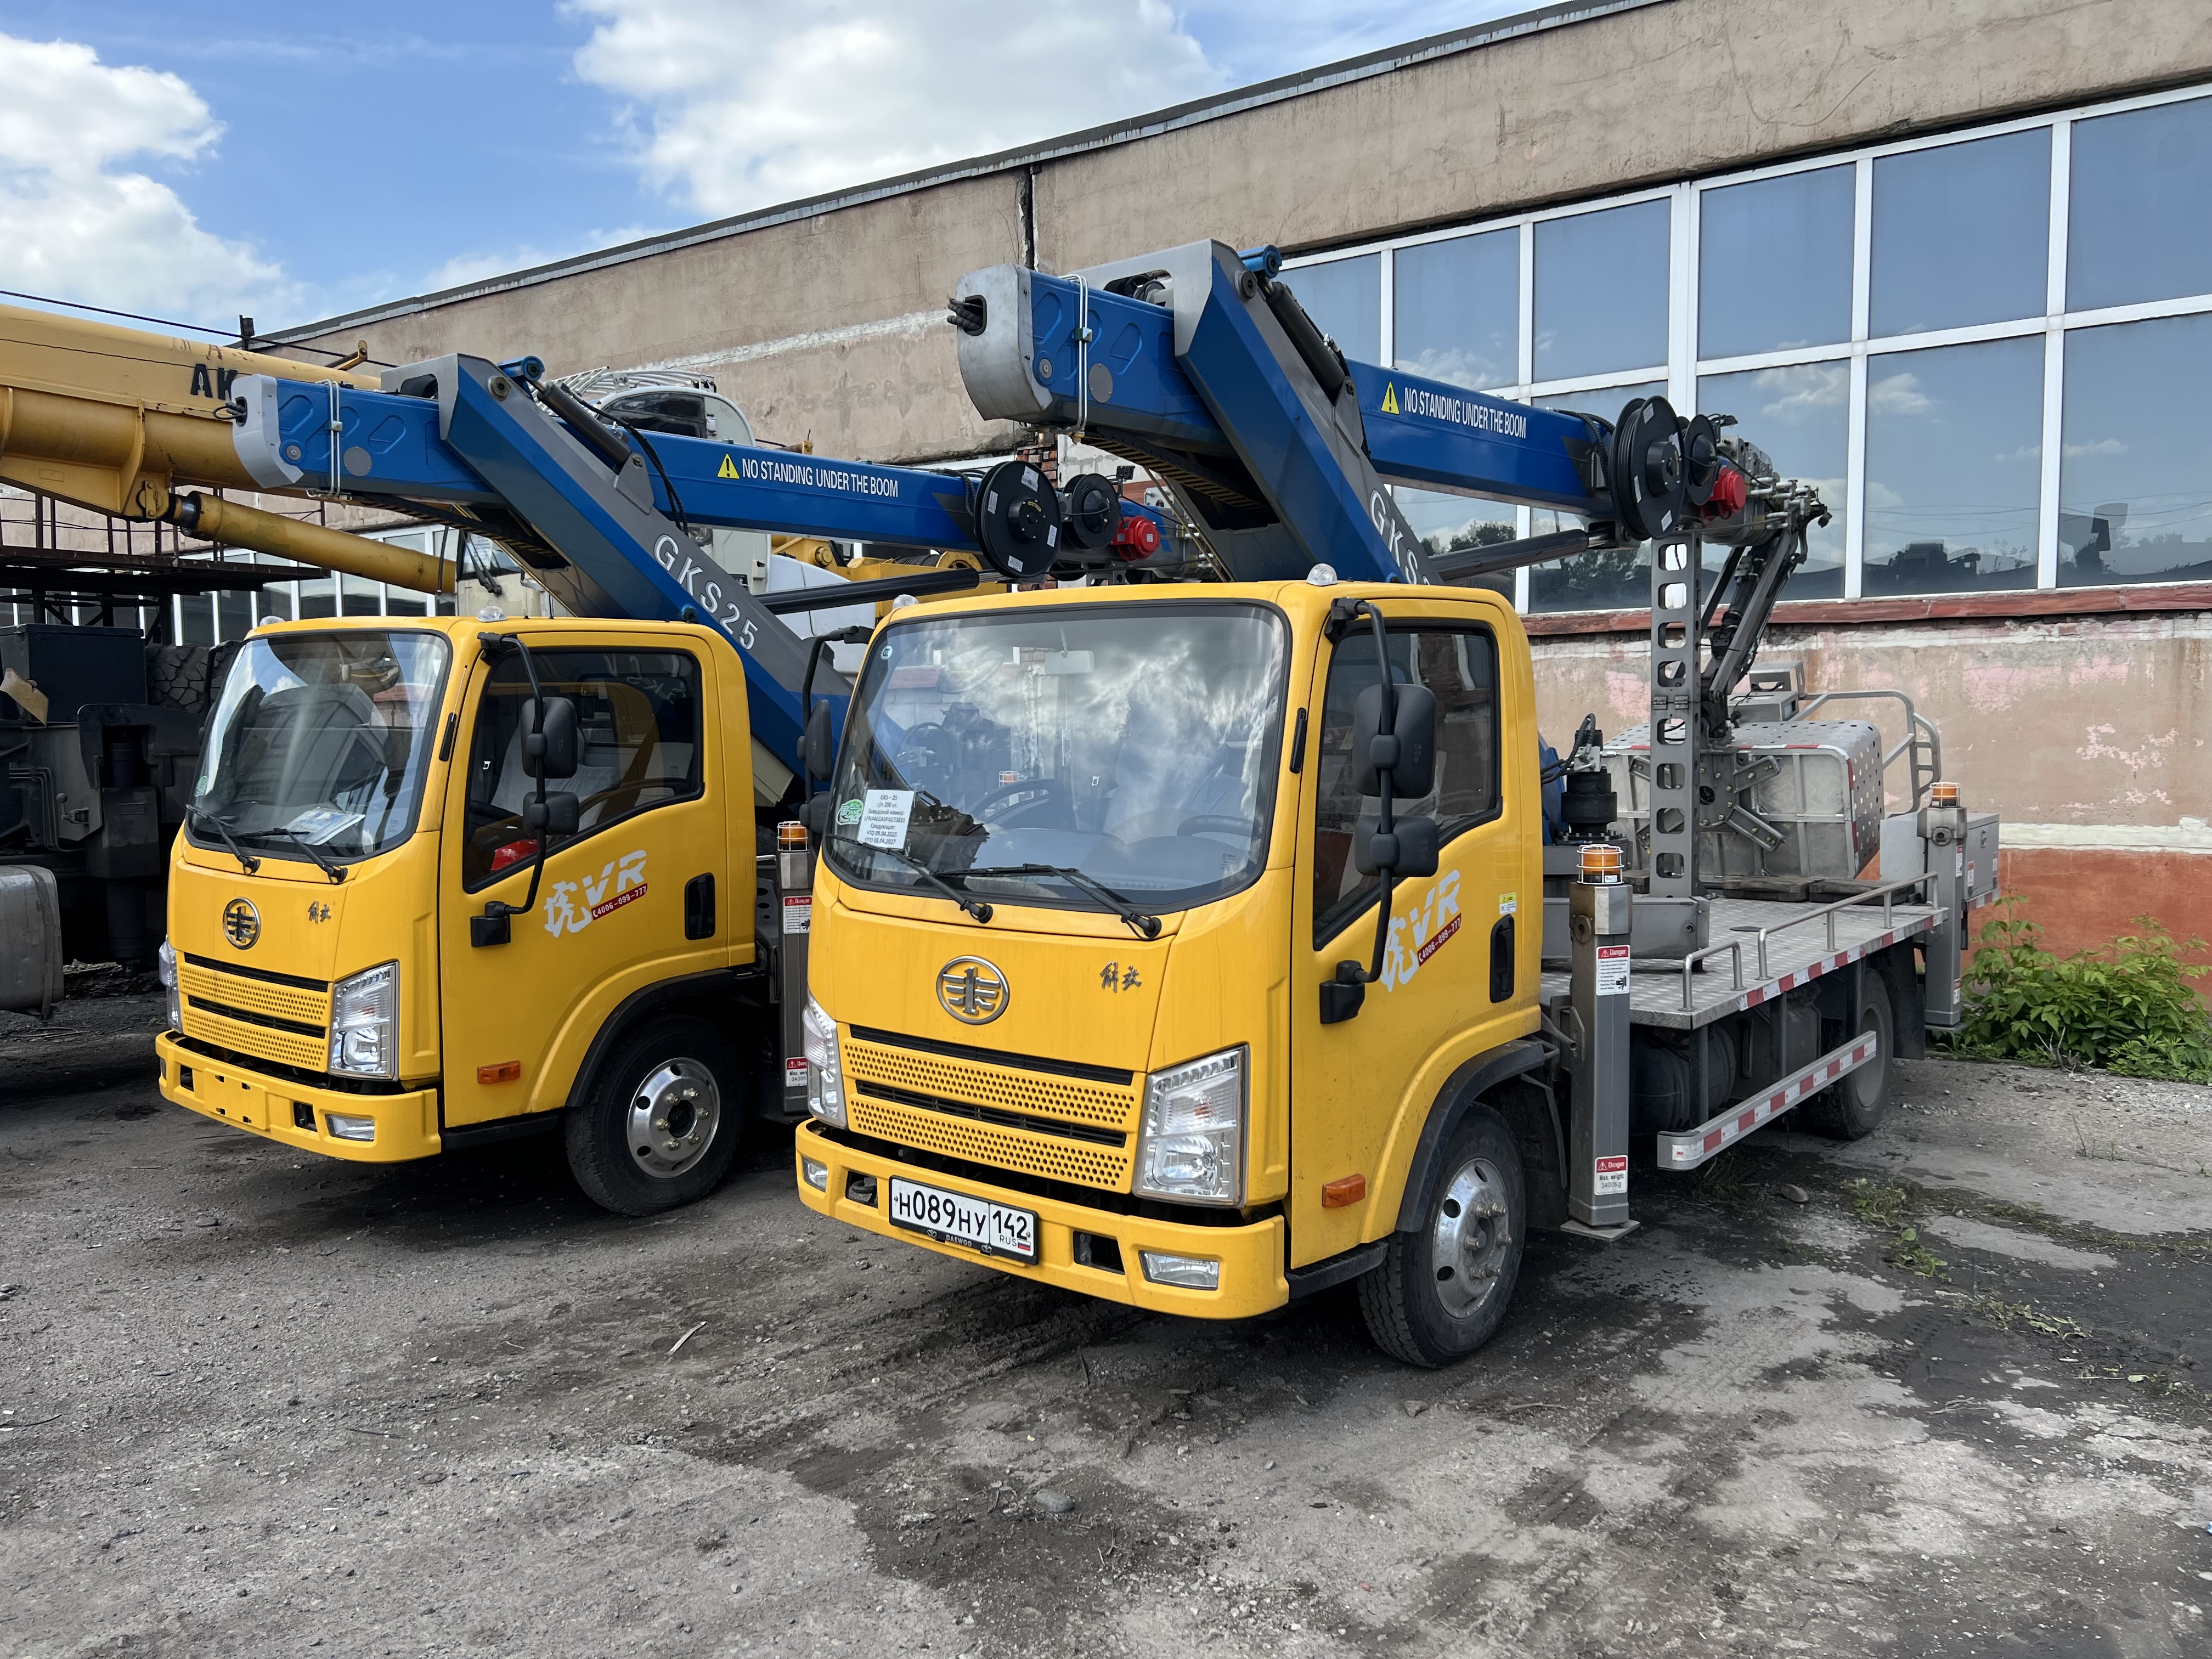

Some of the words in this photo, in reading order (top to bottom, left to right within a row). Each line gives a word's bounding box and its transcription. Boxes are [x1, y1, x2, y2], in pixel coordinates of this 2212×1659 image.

[1404, 387, 1418, 414] NO
[1419, 391, 1460, 424] STANDING
[1463, 401, 1488, 430] UNDER
[1489, 409, 1503, 433] THE
[1504, 413, 1527, 439] BOOM
[742, 459, 759, 479] NO
[761, 461, 813, 486] STANDING
[816, 469, 849, 491] UNDER
[851, 474, 868, 494] THE
[871, 476, 898, 498] BOOM
[1370, 489, 1430, 585] GKS
[653, 534, 758, 650] GKS25
[1609, 949, 1627, 957] Danger
[945, 1234, 973, 1248] DAEWOO
[992, 1210, 1028, 1240] 142
[1000, 1235, 1017, 1247] RUS
